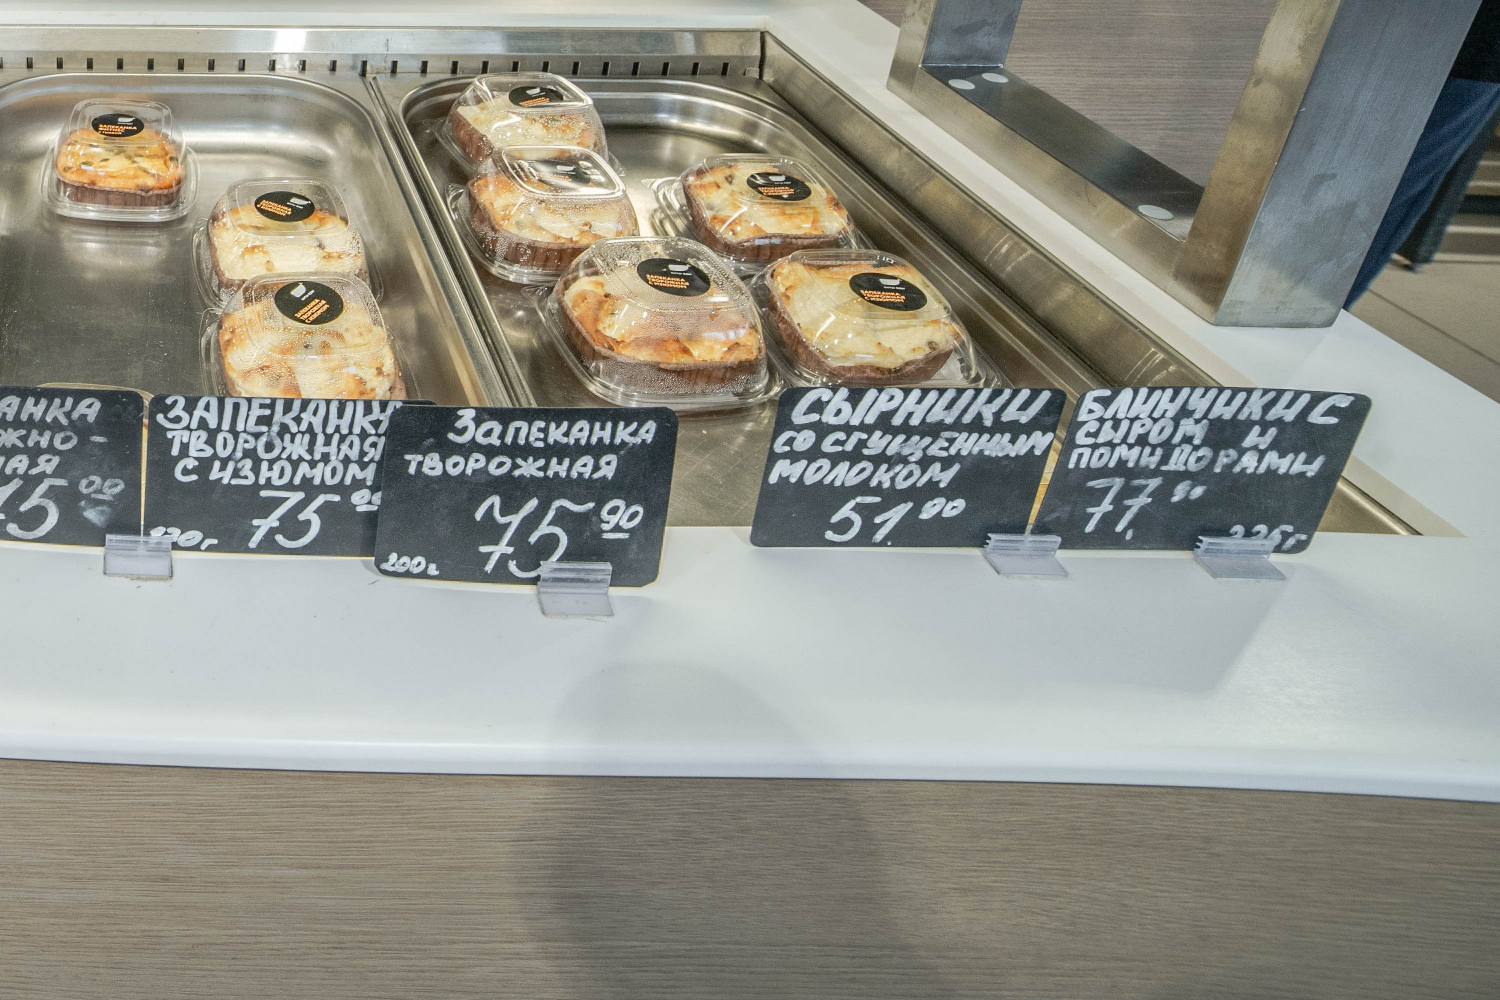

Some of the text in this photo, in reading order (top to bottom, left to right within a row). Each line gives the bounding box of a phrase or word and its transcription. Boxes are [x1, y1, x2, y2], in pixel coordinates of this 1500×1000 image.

[791, 387, 1052, 427] СЫРНИКИ
[1077, 386, 1312, 423] БЛИНЧИКИ
[166, 430, 386, 462] ТВОРОЖНАЯ
[1075, 417, 1209, 445] СЫРОМ
[208, 458, 377, 486] ИЗЮМОМ
[404, 453, 618, 480] ТВОРОЖНАЯ
[768, 458, 961, 490] МОЛОКОМ
[1068, 443, 1326, 478] ПОМИДОРАМИ
